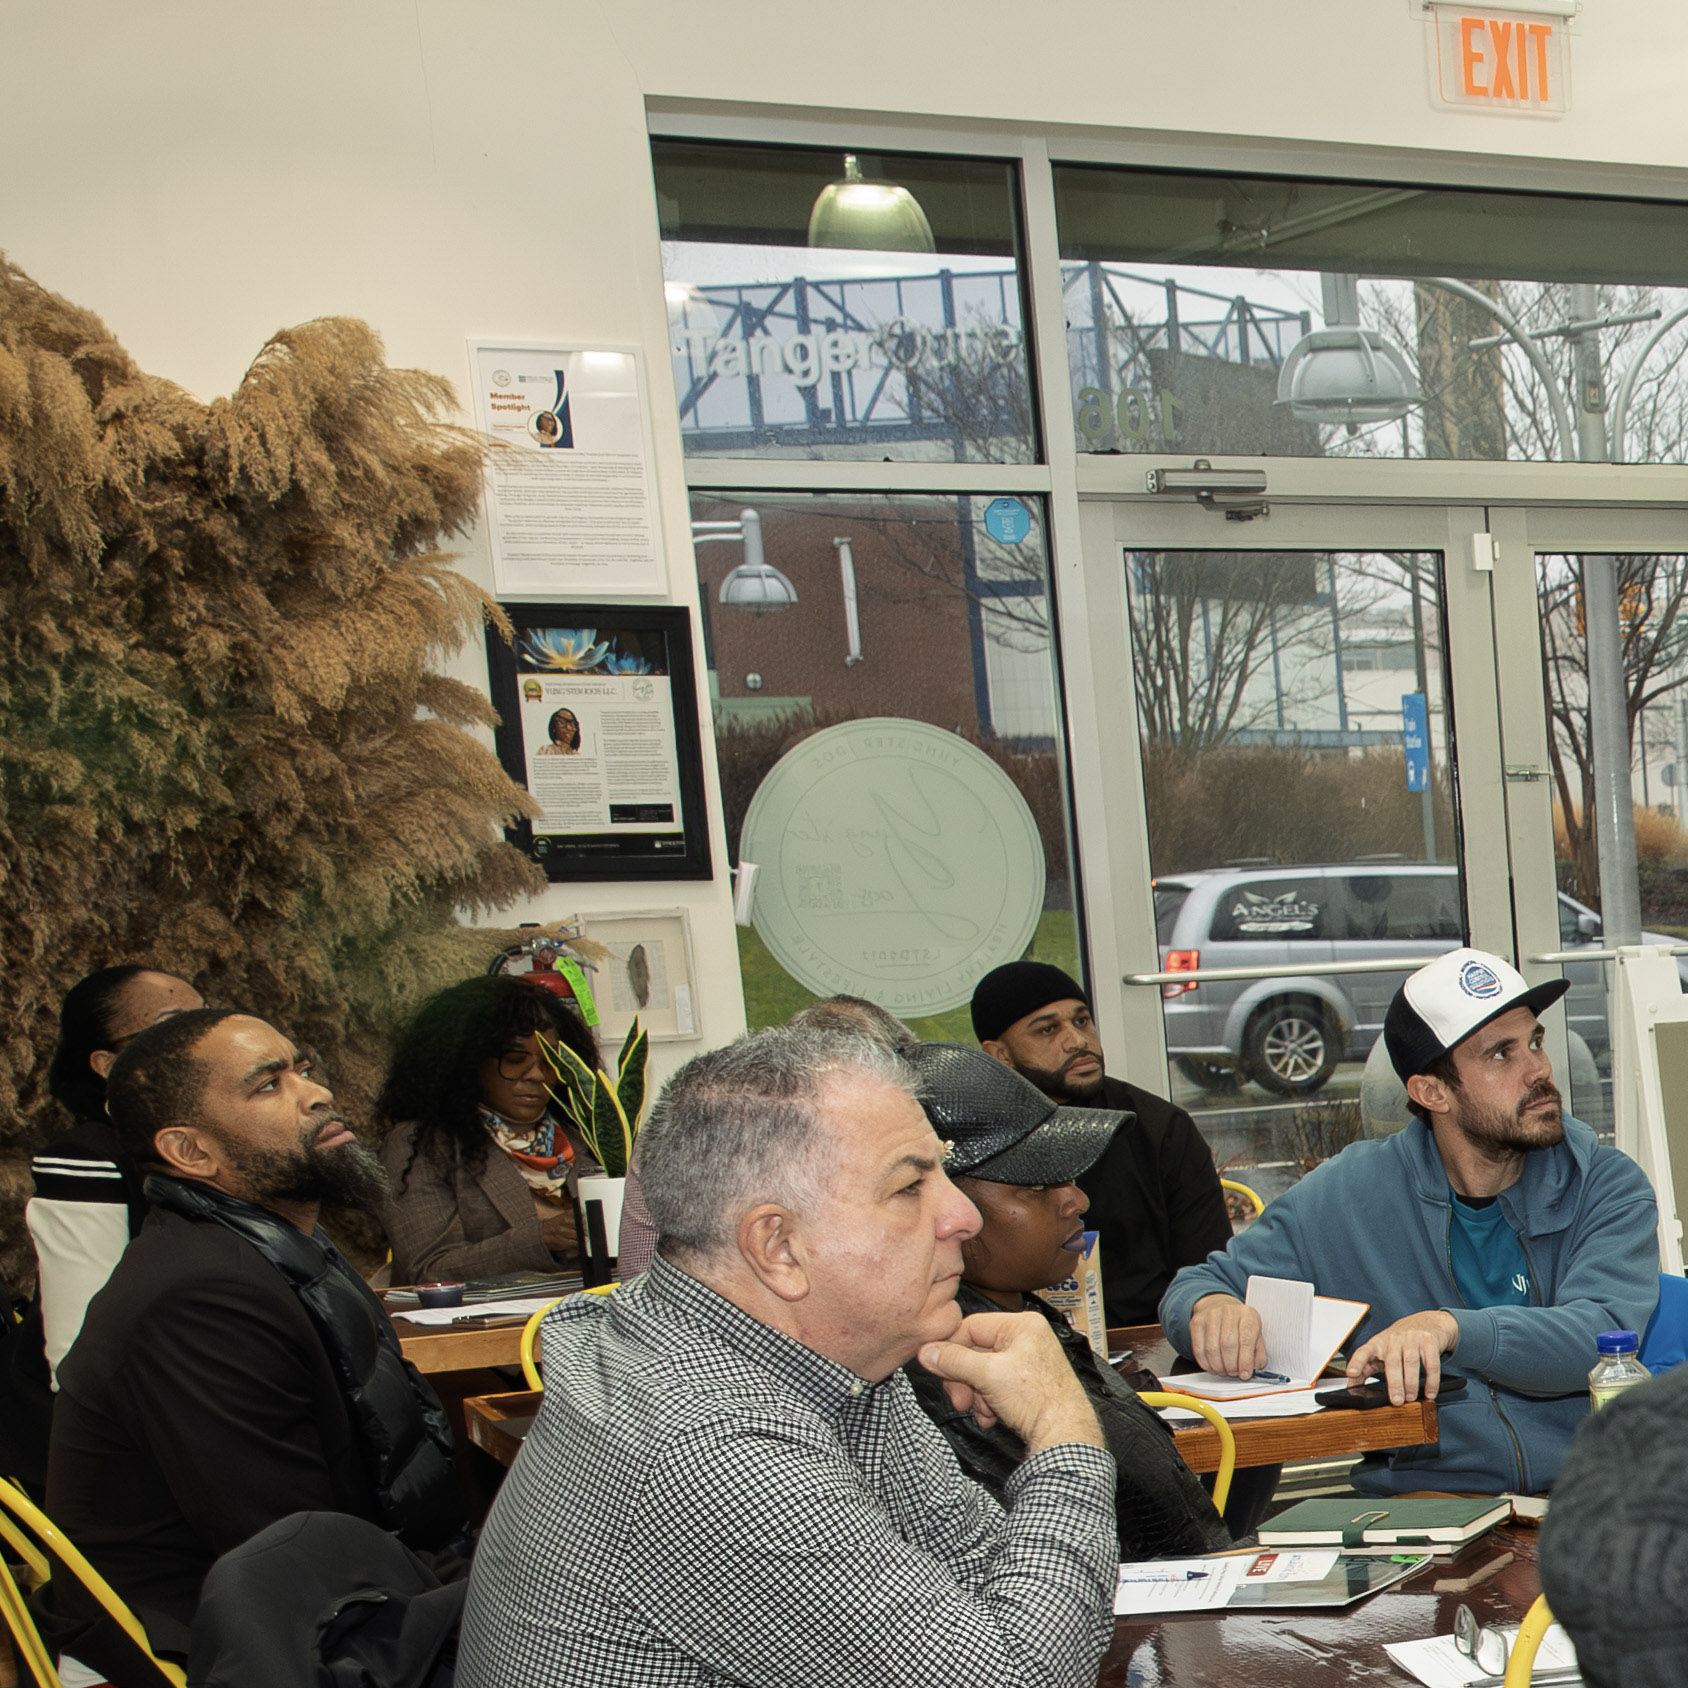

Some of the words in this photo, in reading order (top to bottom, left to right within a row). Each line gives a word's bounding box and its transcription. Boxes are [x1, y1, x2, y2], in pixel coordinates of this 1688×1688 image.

[1461, 18, 1552, 102] EXIT
[490, 392, 525, 401] Member
[491, 403, 531, 412] Spotlight
